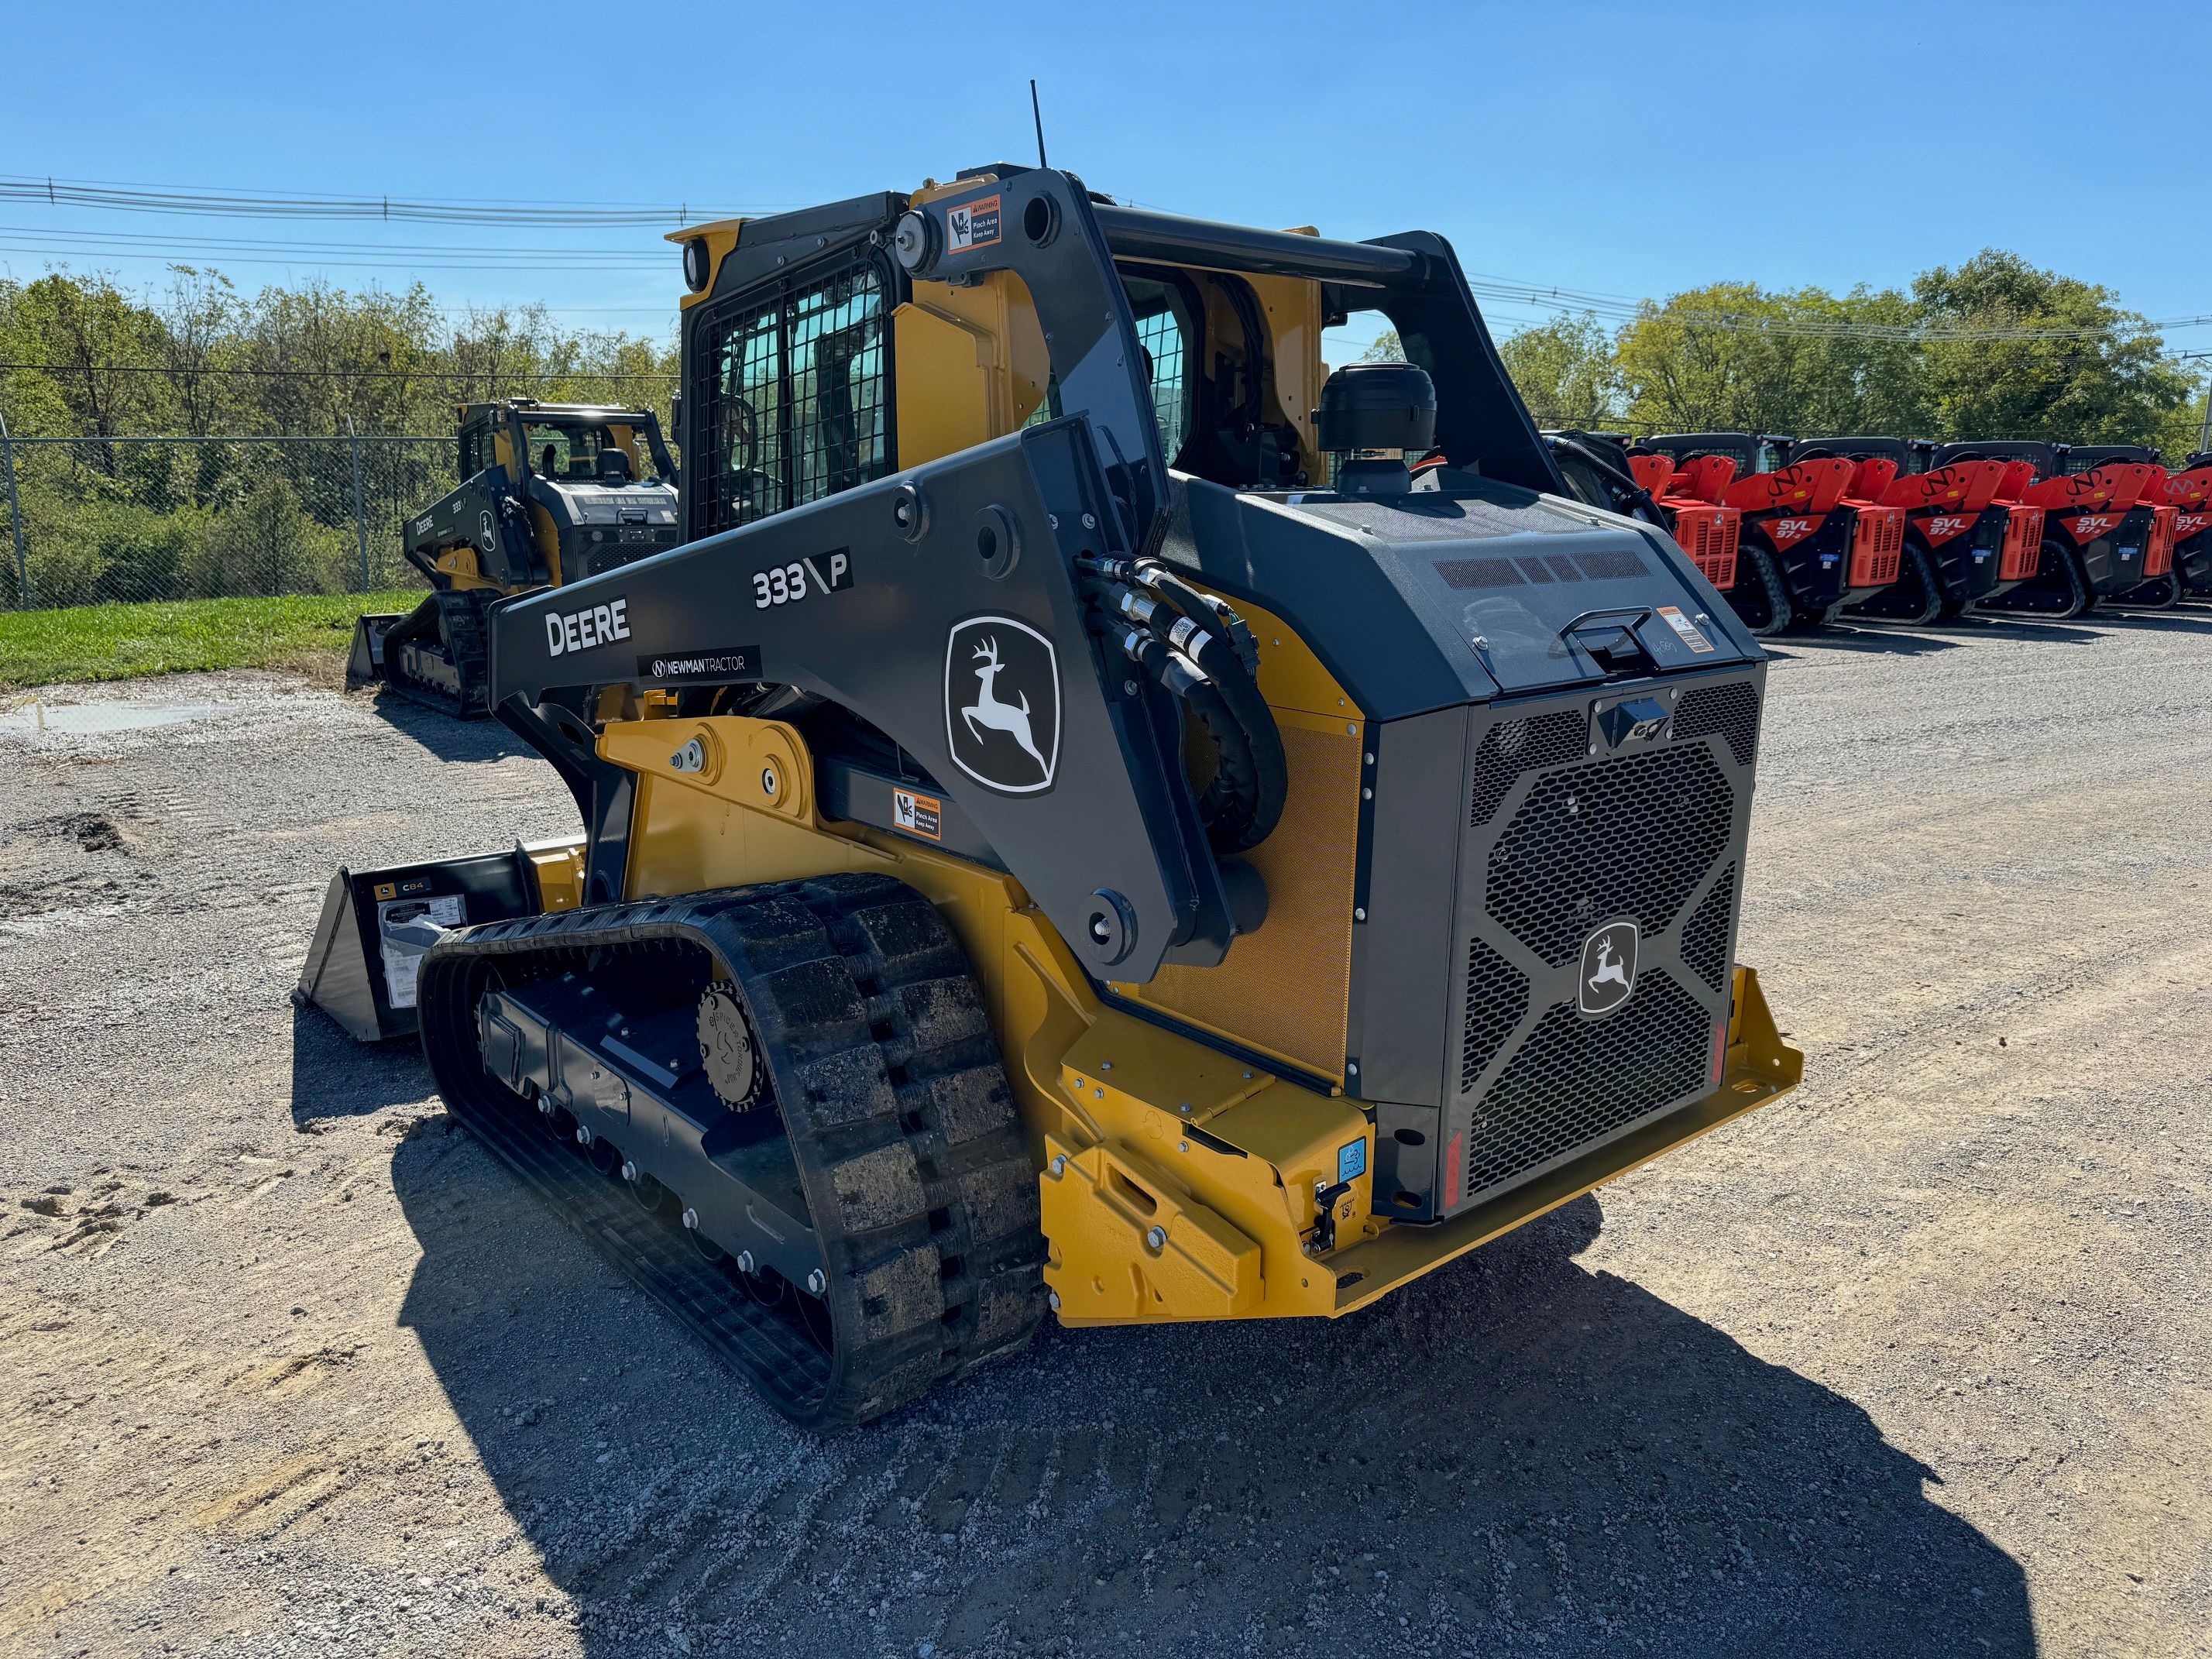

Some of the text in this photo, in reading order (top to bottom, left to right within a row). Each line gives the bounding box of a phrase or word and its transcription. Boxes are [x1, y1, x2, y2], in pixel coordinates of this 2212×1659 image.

[977, 200, 998, 211] WARNING
[973, 218, 998, 229] Pinch Area
[983, 228, 994, 237] Away
[416, 514, 434, 536] DEERE
[1777, 520, 1812, 531] SVL
[1930, 518, 1966, 528] SVL
[2076, 517, 2112, 527] SVL
[2176, 516, 2207, 525] SVL
[544, 599, 630, 657] DEERE
[919, 798, 938, 809] WARNING
[916, 812, 938, 823] Pinch Area
